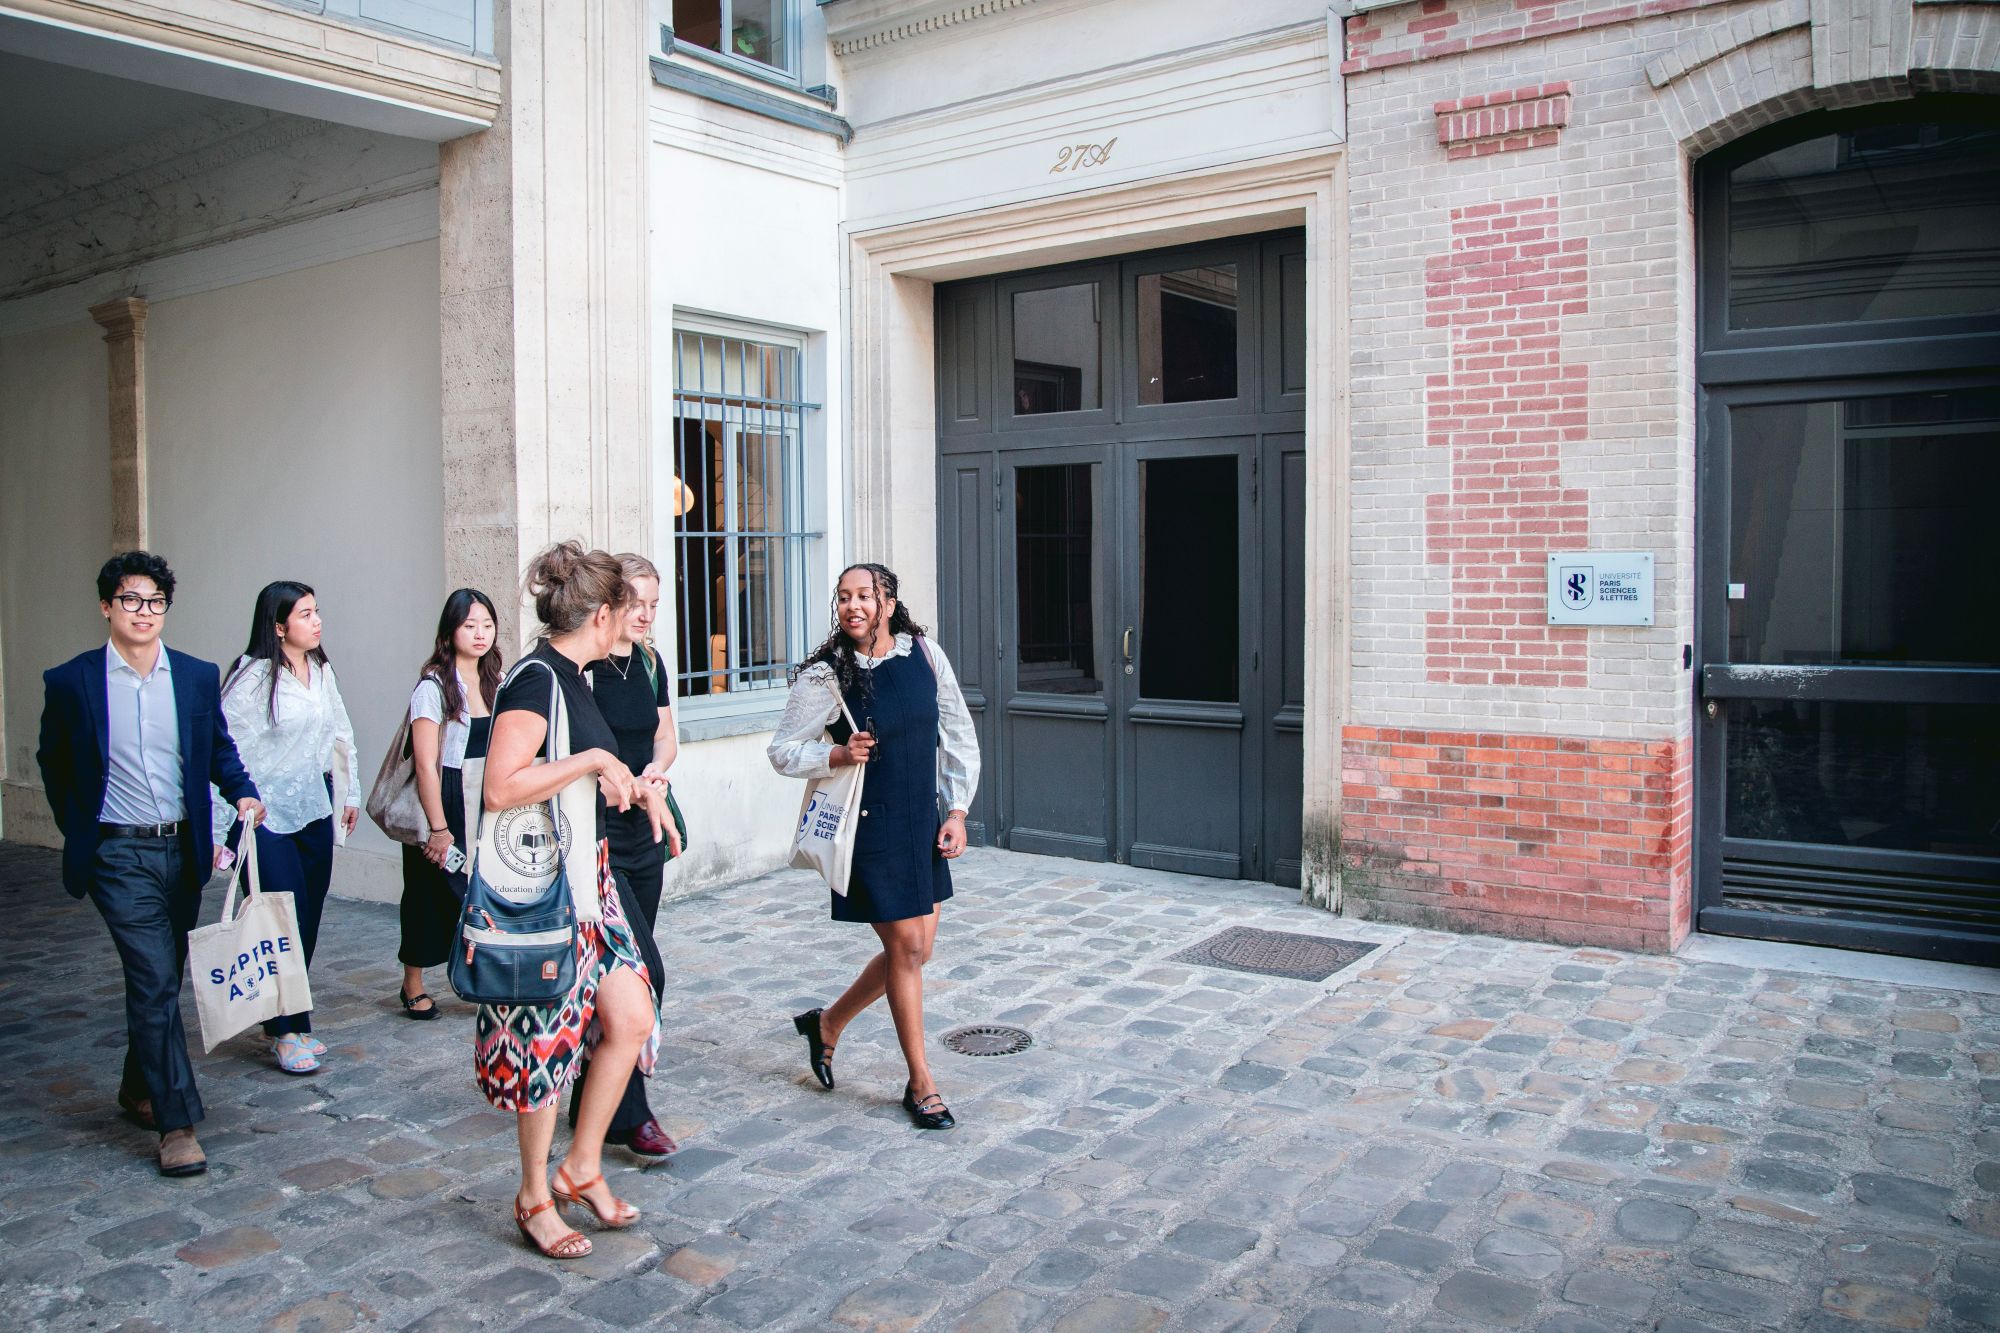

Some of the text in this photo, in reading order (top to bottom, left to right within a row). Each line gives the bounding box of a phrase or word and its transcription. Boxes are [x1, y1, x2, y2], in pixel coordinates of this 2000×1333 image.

[1048, 136, 1118, 174] 27A
[1600, 572, 1641, 580] UNIVERSITÉ
[818, 810, 841, 824] PARIS
[494, 885, 533, 894] Education
